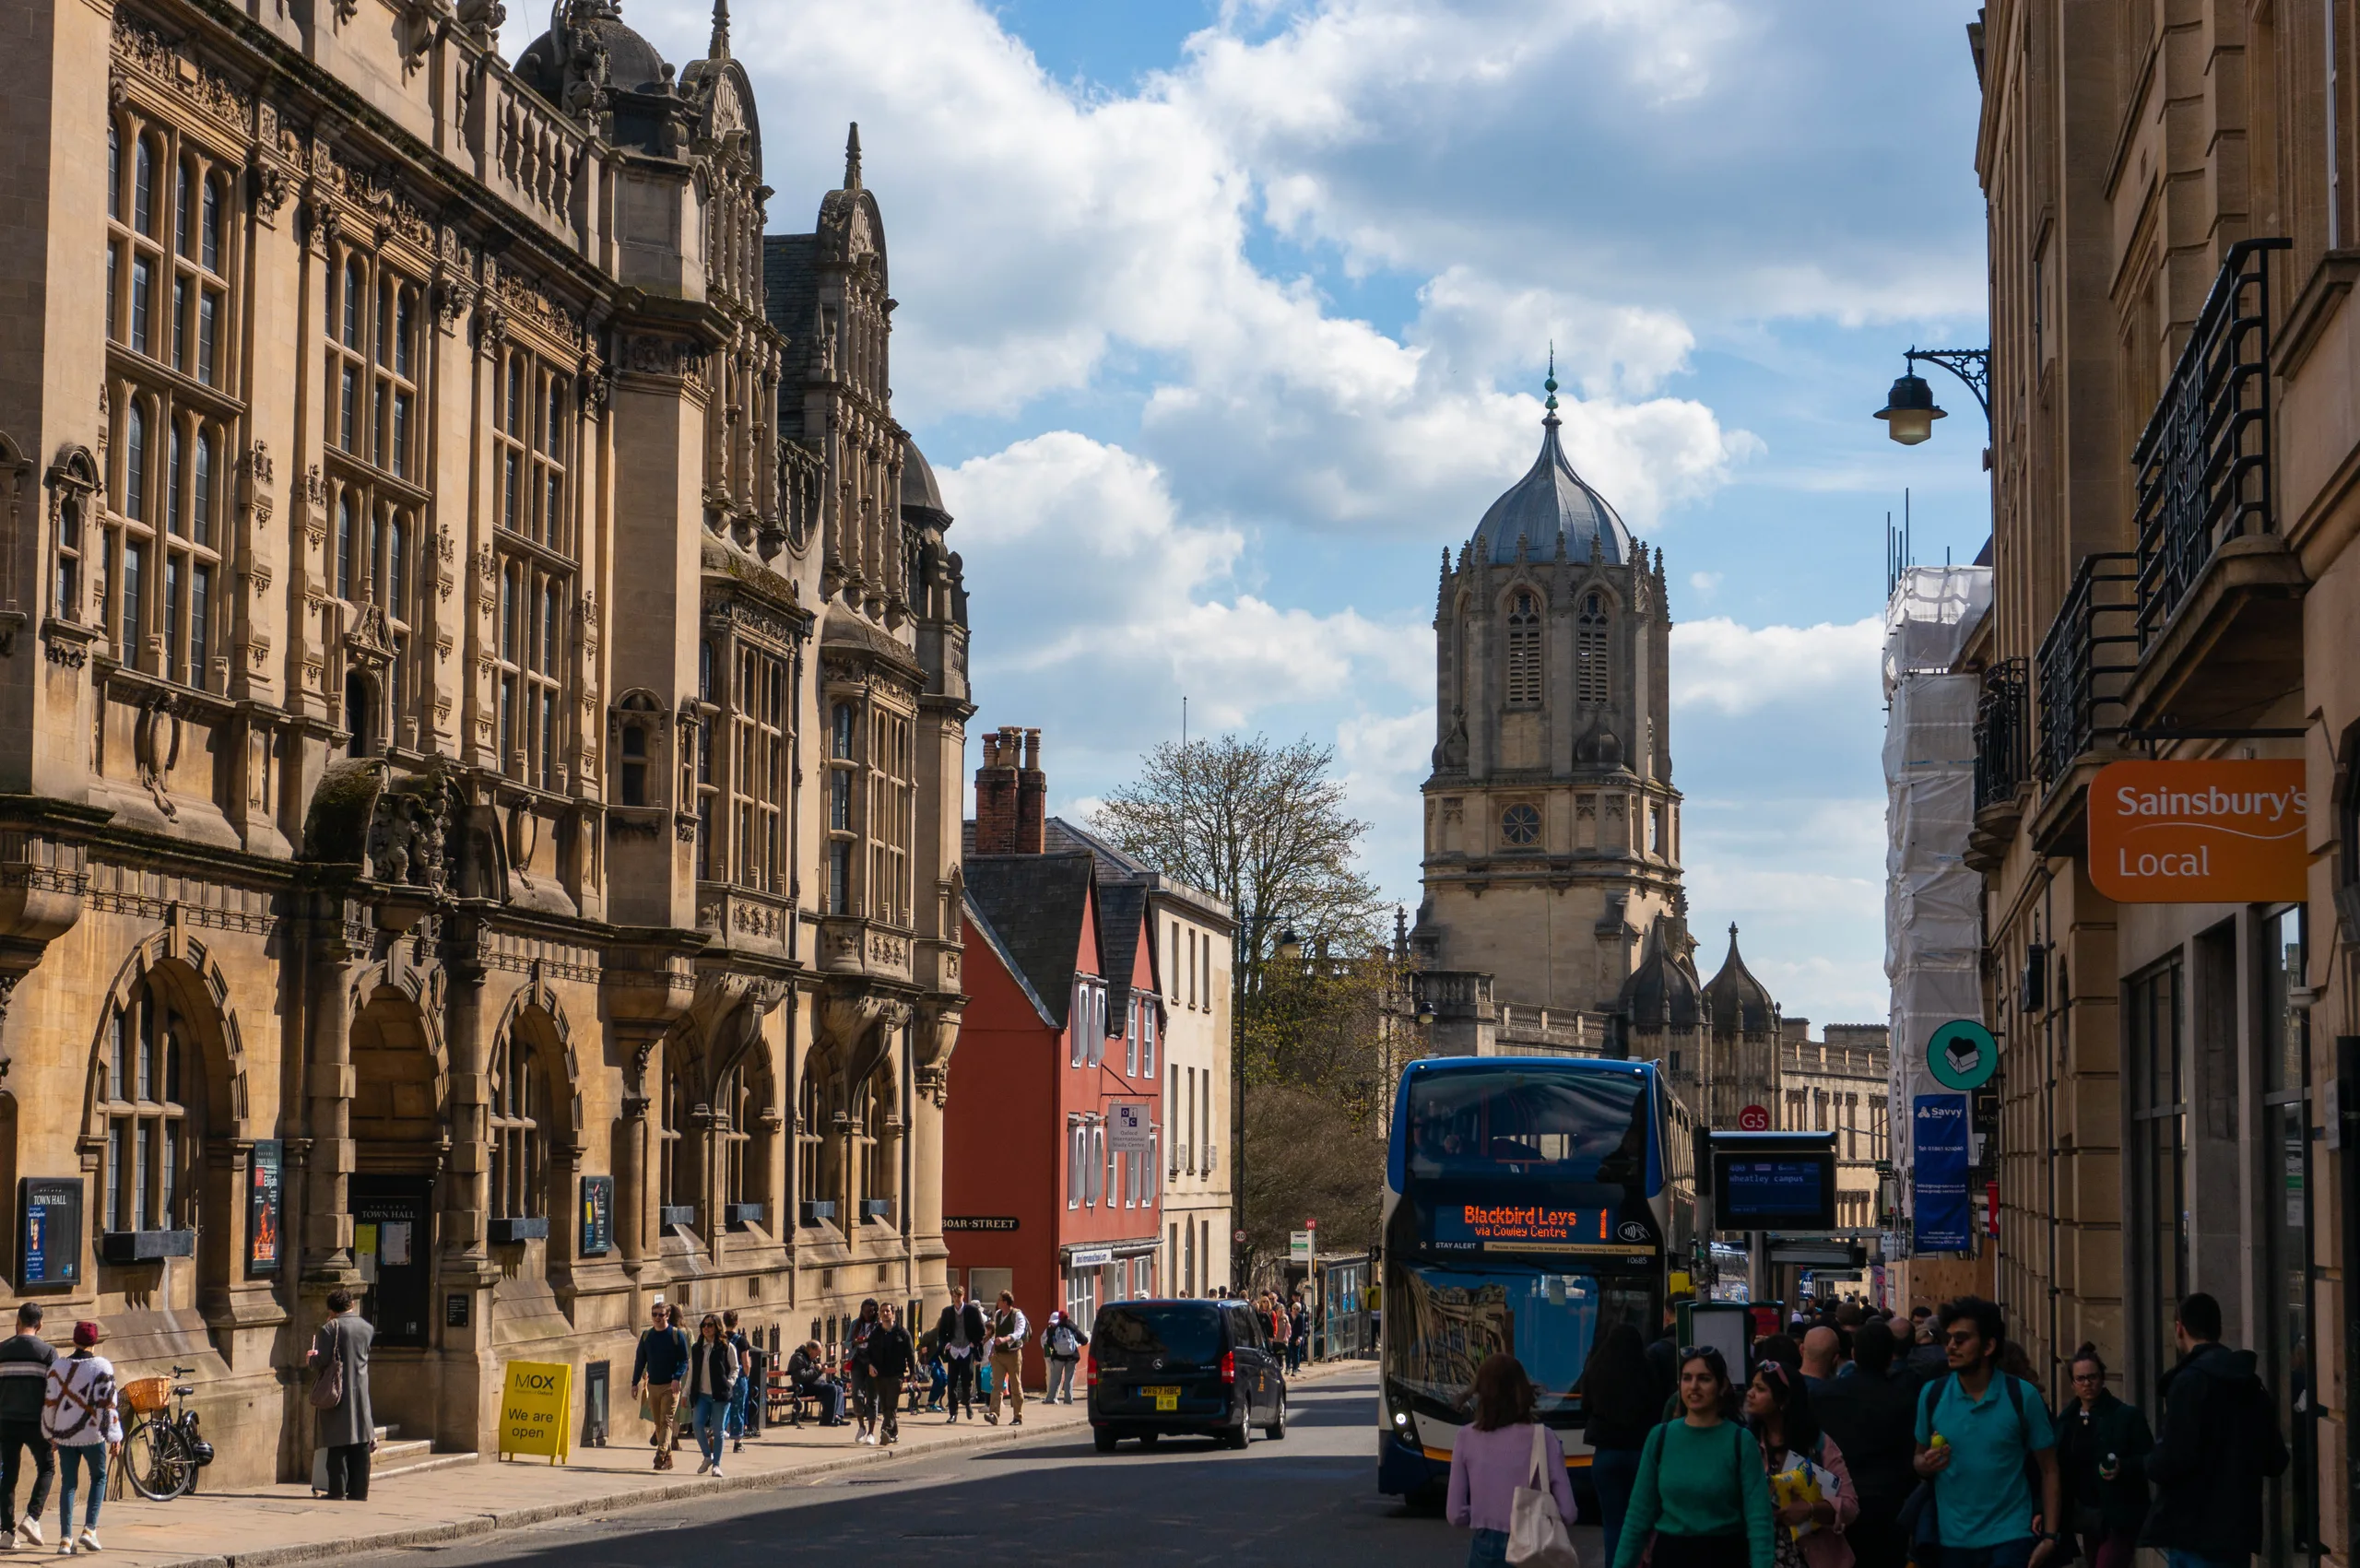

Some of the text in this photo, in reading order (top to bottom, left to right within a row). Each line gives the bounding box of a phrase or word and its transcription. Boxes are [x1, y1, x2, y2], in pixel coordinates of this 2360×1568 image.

[2117, 785, 2308, 822] Sainsbury's
[2119, 845, 2211, 877] Local
[1931, 1107, 1962, 1118] Savvy
[1741, 1114, 1765, 1128] G5
[1774, 1175, 1803, 1184] campus
[33, 1195, 66, 1205] TOWN HALL
[361, 1210, 416, 1219] TOWN HALL
[1464, 1205, 1576, 1226] Blackbird Leys
[942, 1220, 1015, 1229] BOAR STREET
[1599, 1208, 1607, 1239] 1
[1475, 1224, 1567, 1238] via Cowley Centre
[1626, 1256, 1647, 1265] 10685
[514, 1373, 555, 1389] MOX
[1142, 1386, 1181, 1396] WR67 HBC
[508, 1408, 553, 1423] We are
[512, 1427, 544, 1440] open
